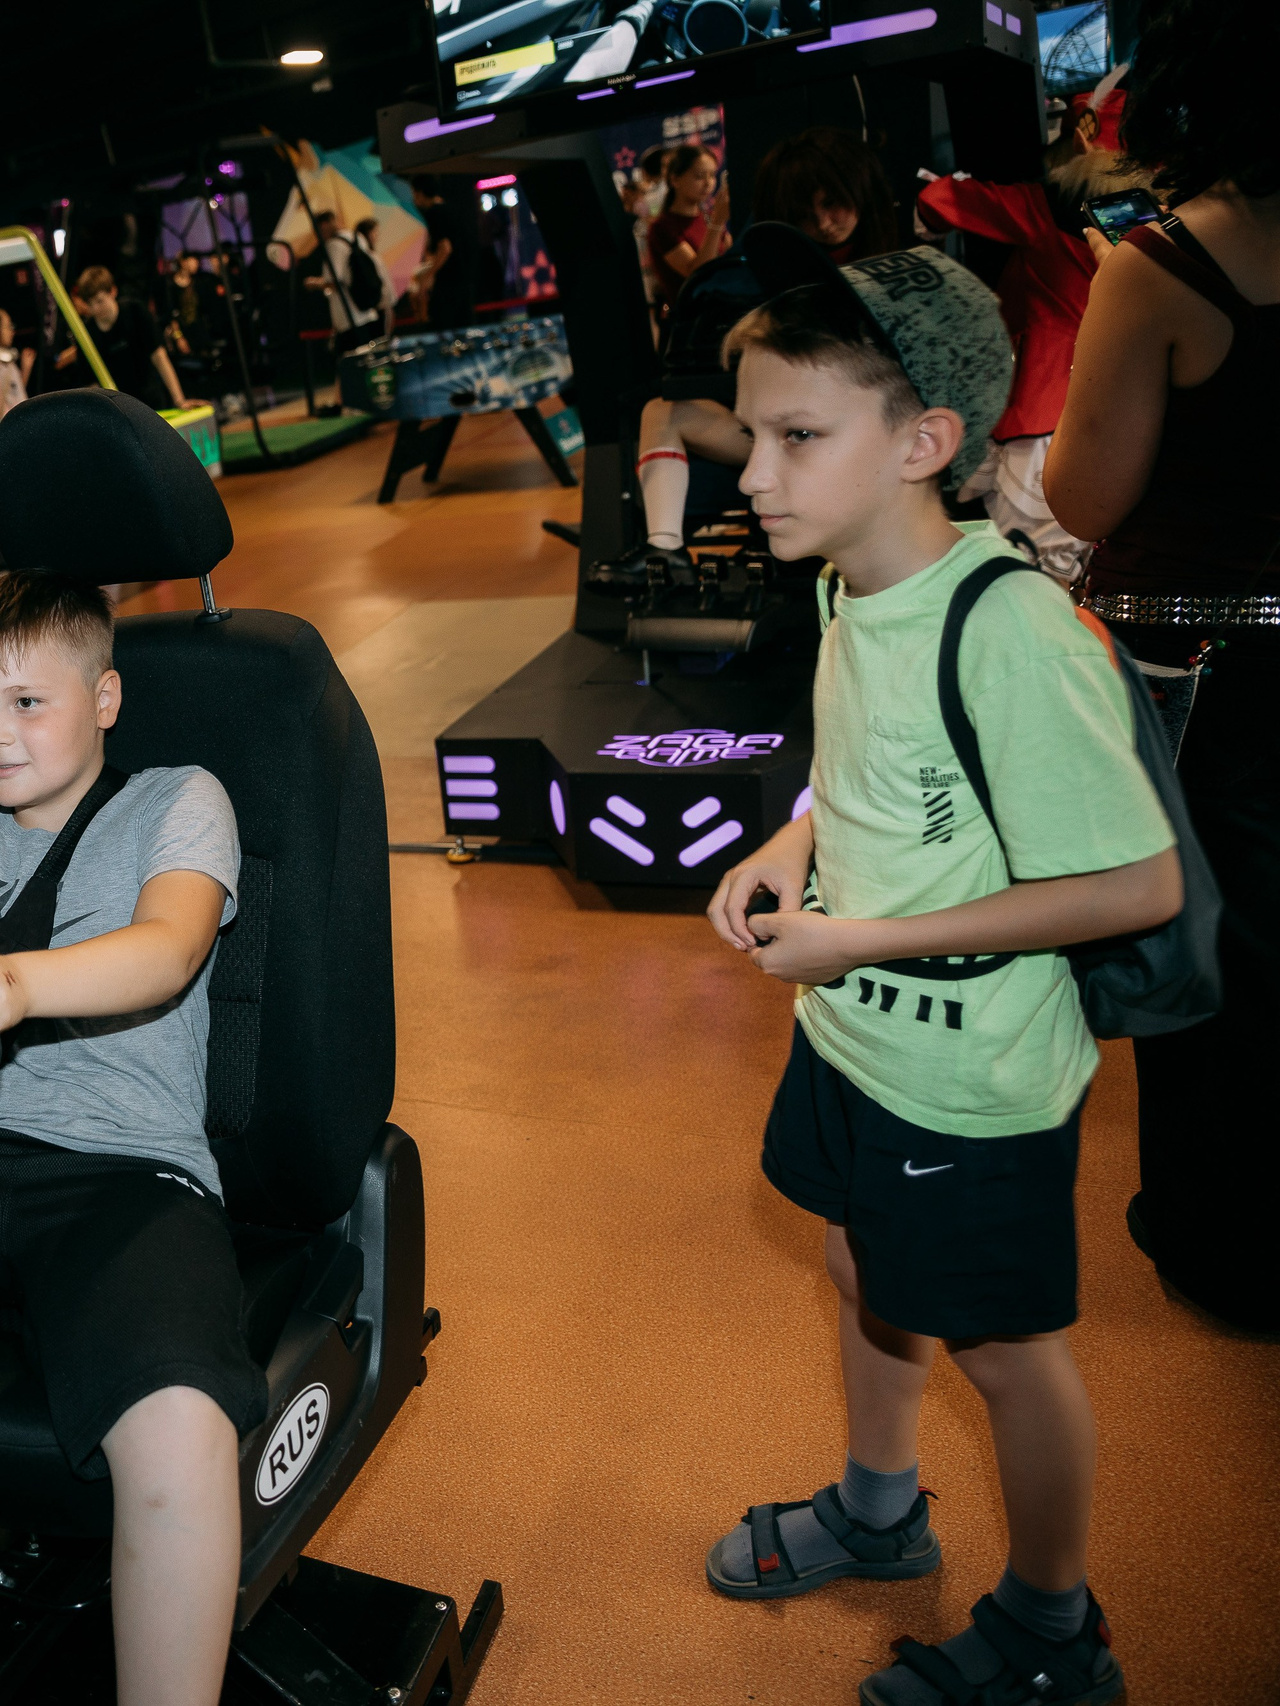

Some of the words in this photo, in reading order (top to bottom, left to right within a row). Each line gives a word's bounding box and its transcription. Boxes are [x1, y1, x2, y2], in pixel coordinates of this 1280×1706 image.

[919, 766, 937, 776] NEW
[919, 773, 960, 783] REALITIES
[268, 1398, 320, 1490] RUS
